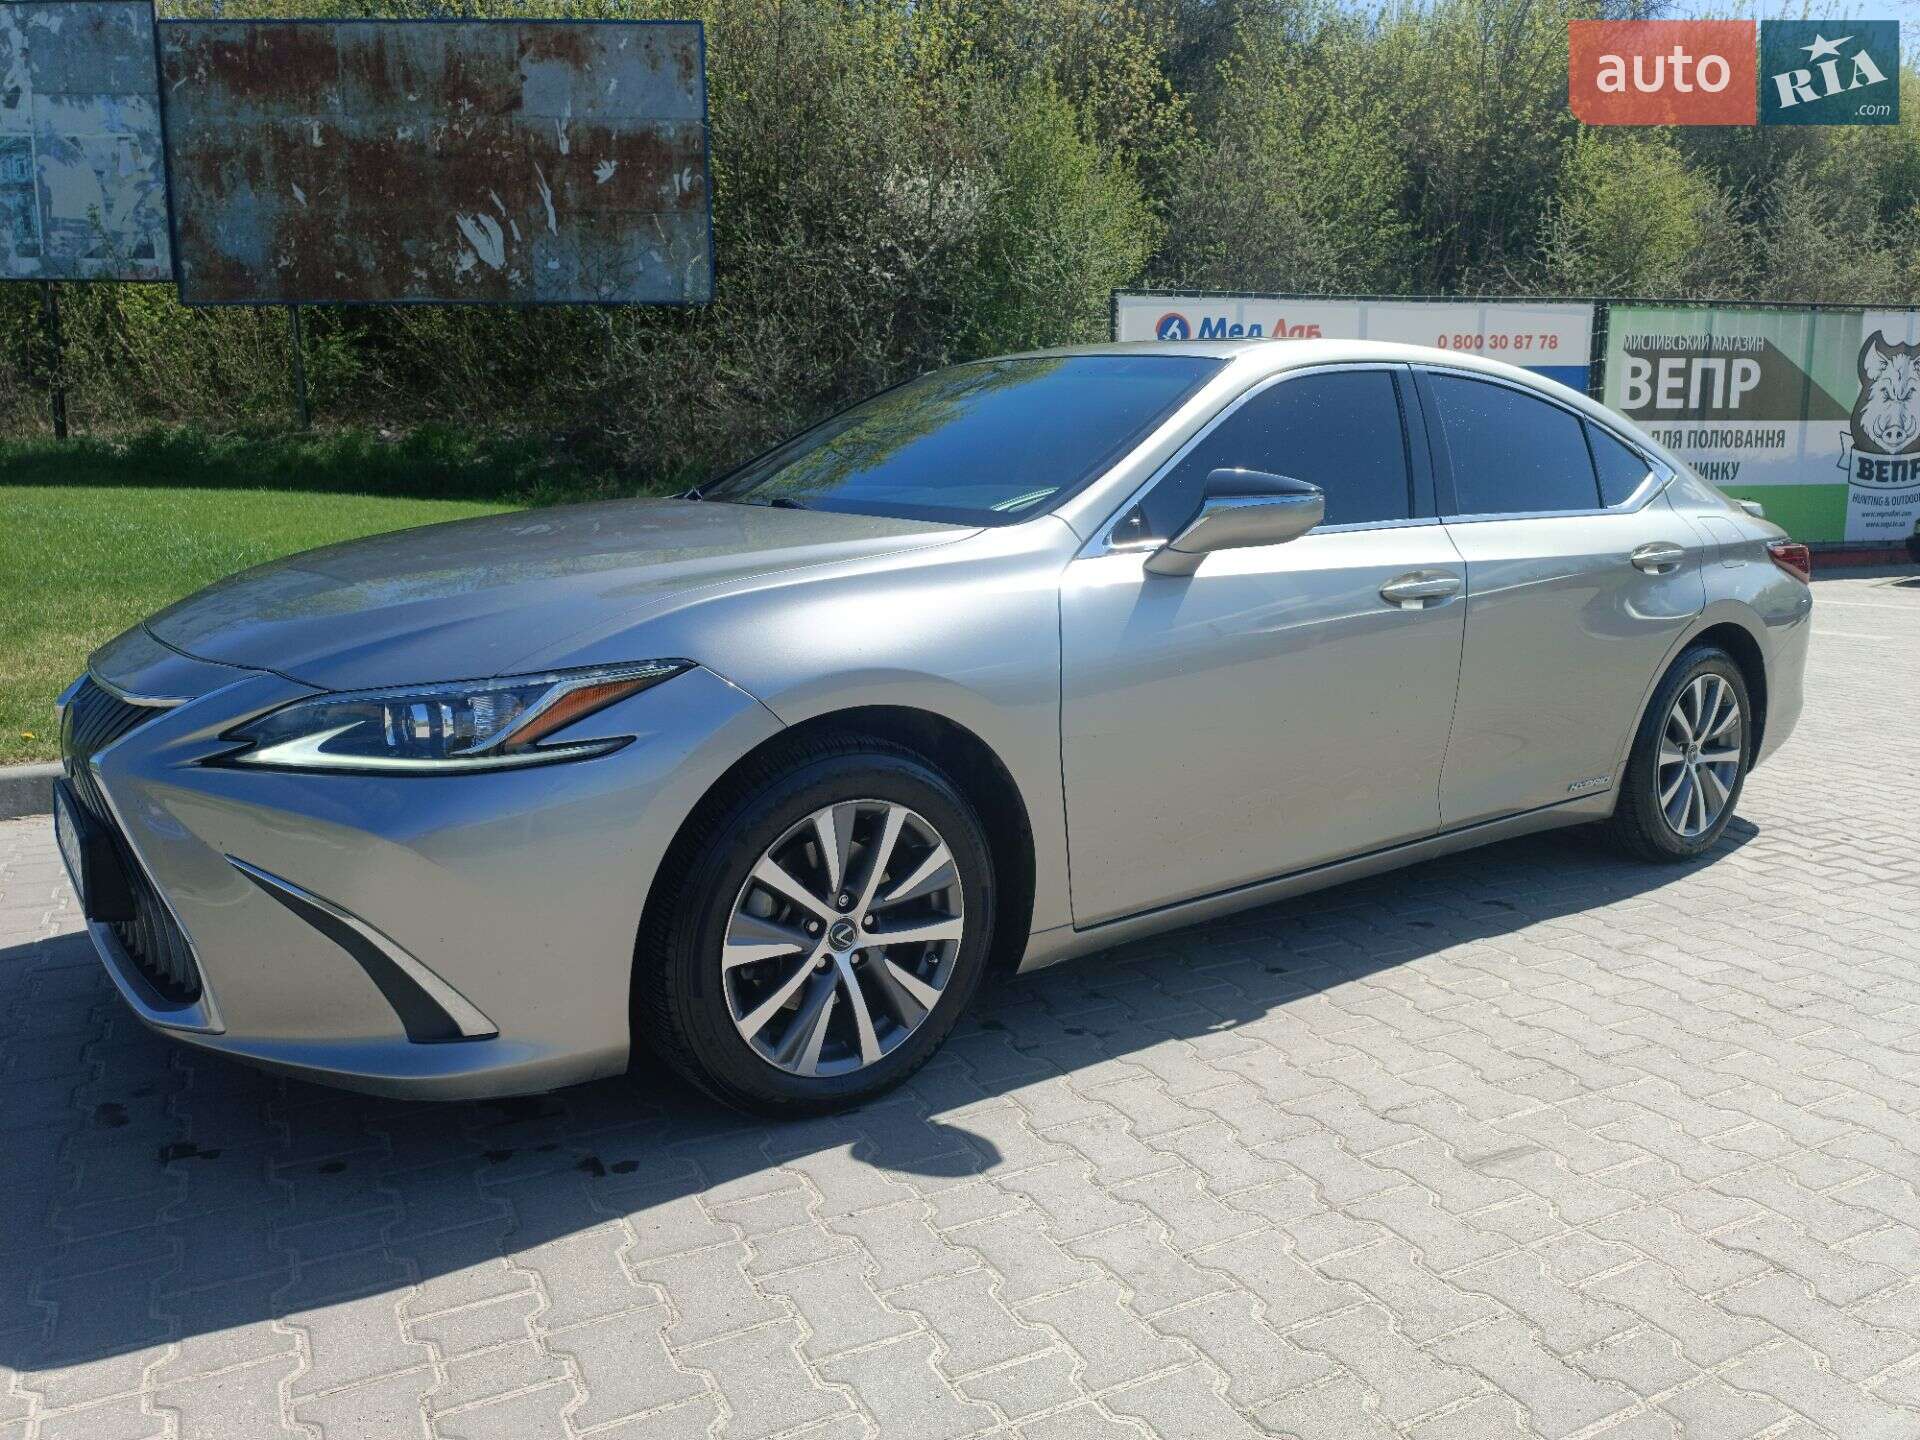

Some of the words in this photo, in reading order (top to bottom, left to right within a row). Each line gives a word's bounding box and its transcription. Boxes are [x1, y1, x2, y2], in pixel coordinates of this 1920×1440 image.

[1438, 334, 1448, 349] 0
[1453, 334, 1484, 349] 800
[1489, 334, 1509, 349] 30
[1514, 335, 1533, 349] 87
[1539, 335, 1558, 349] 78
[1712, 336, 1765, 351] МАГАЗИН
[1620, 357, 1762, 410] ВЕПР
[1687, 429, 1786, 449] ПОЛЮВАННЯ
